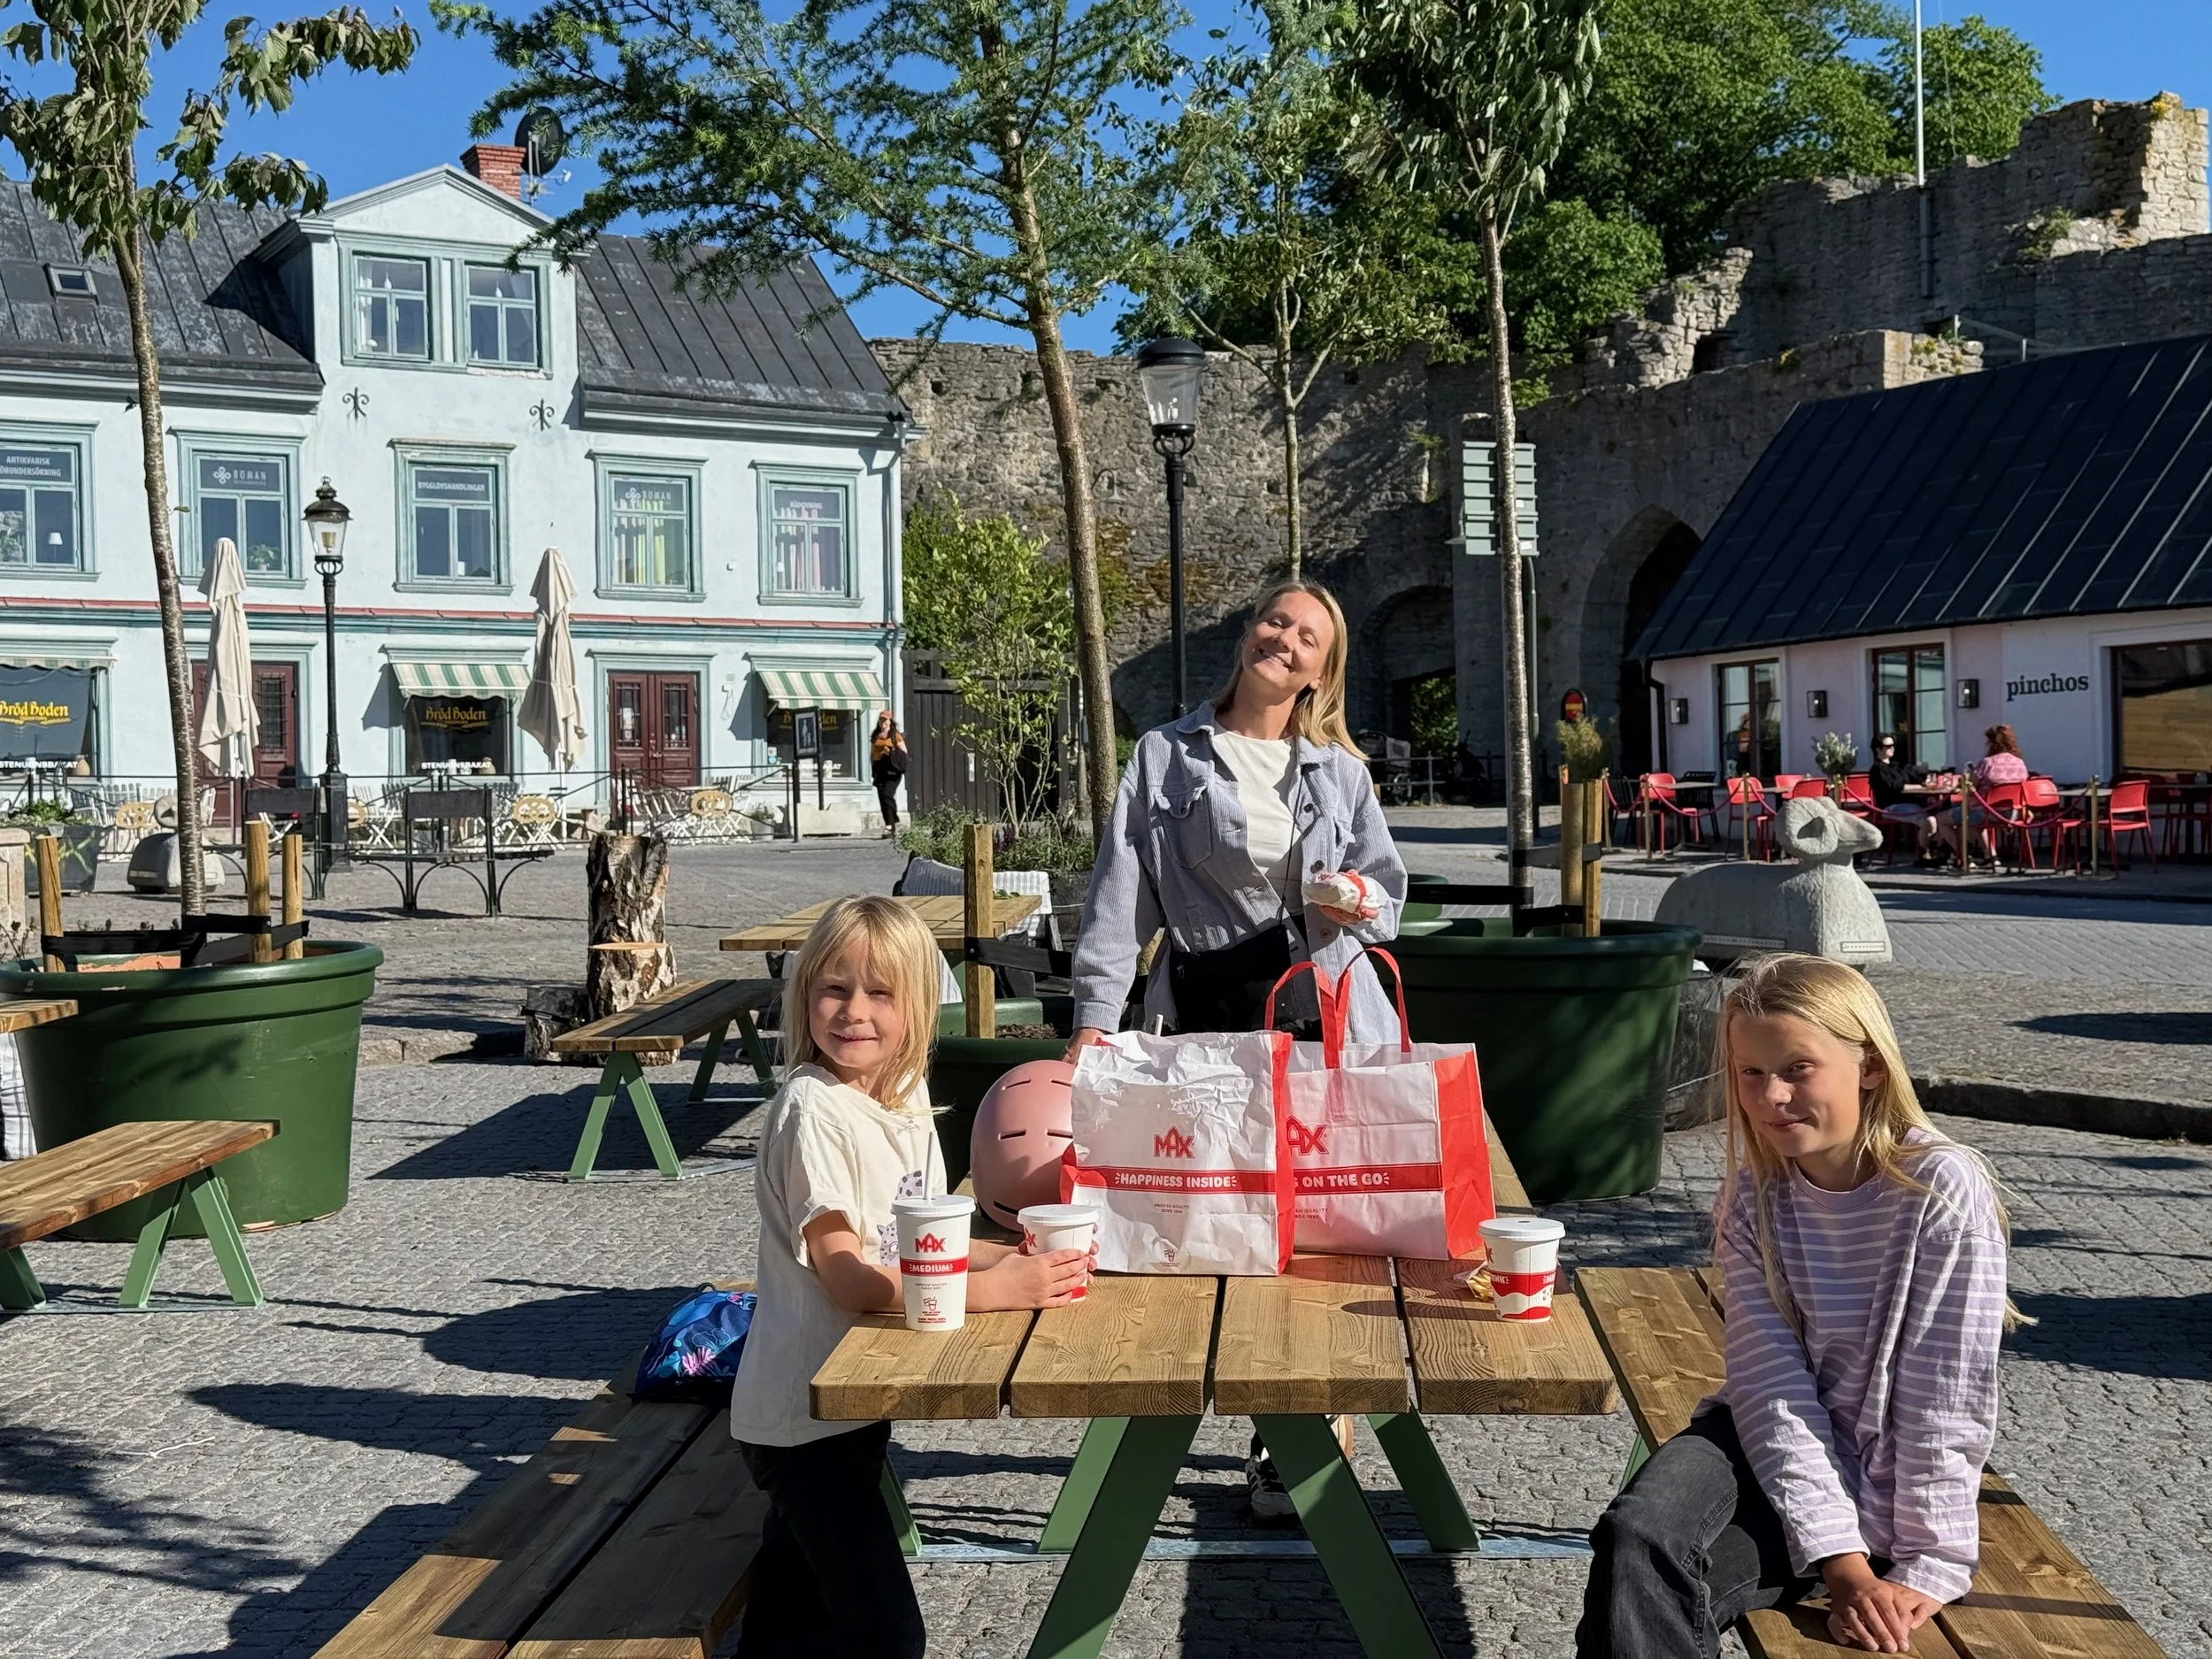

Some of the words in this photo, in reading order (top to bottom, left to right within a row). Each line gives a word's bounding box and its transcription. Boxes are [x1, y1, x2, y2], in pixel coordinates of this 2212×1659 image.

[6, 456, 50, 465] ANTIKVARISK
[0, 465, 62, 477] ÖRUNDERSÖKNING
[2006, 672, 2089, 703] pinchos
[0, 700, 28, 717] Bröd
[29, 701, 69, 717] Boden
[426, 706, 451, 720] Bröd
[453, 706, 486, 720] Boden
[1153, 1125, 1194, 1159] MAX
[1286, 1116, 1329, 1156] AX
[1120, 1173, 1183, 1188] HAPPINESS
[1186, 1176, 1231, 1188] INSIDE
[1302, 1176, 1324, 1187] ON
[1326, 1174, 1358, 1187] THE
[1361, 1172, 1383, 1186] GO
[914, 1233, 947, 1253] MAX
[912, 1264, 949, 1273] MEDIUM
